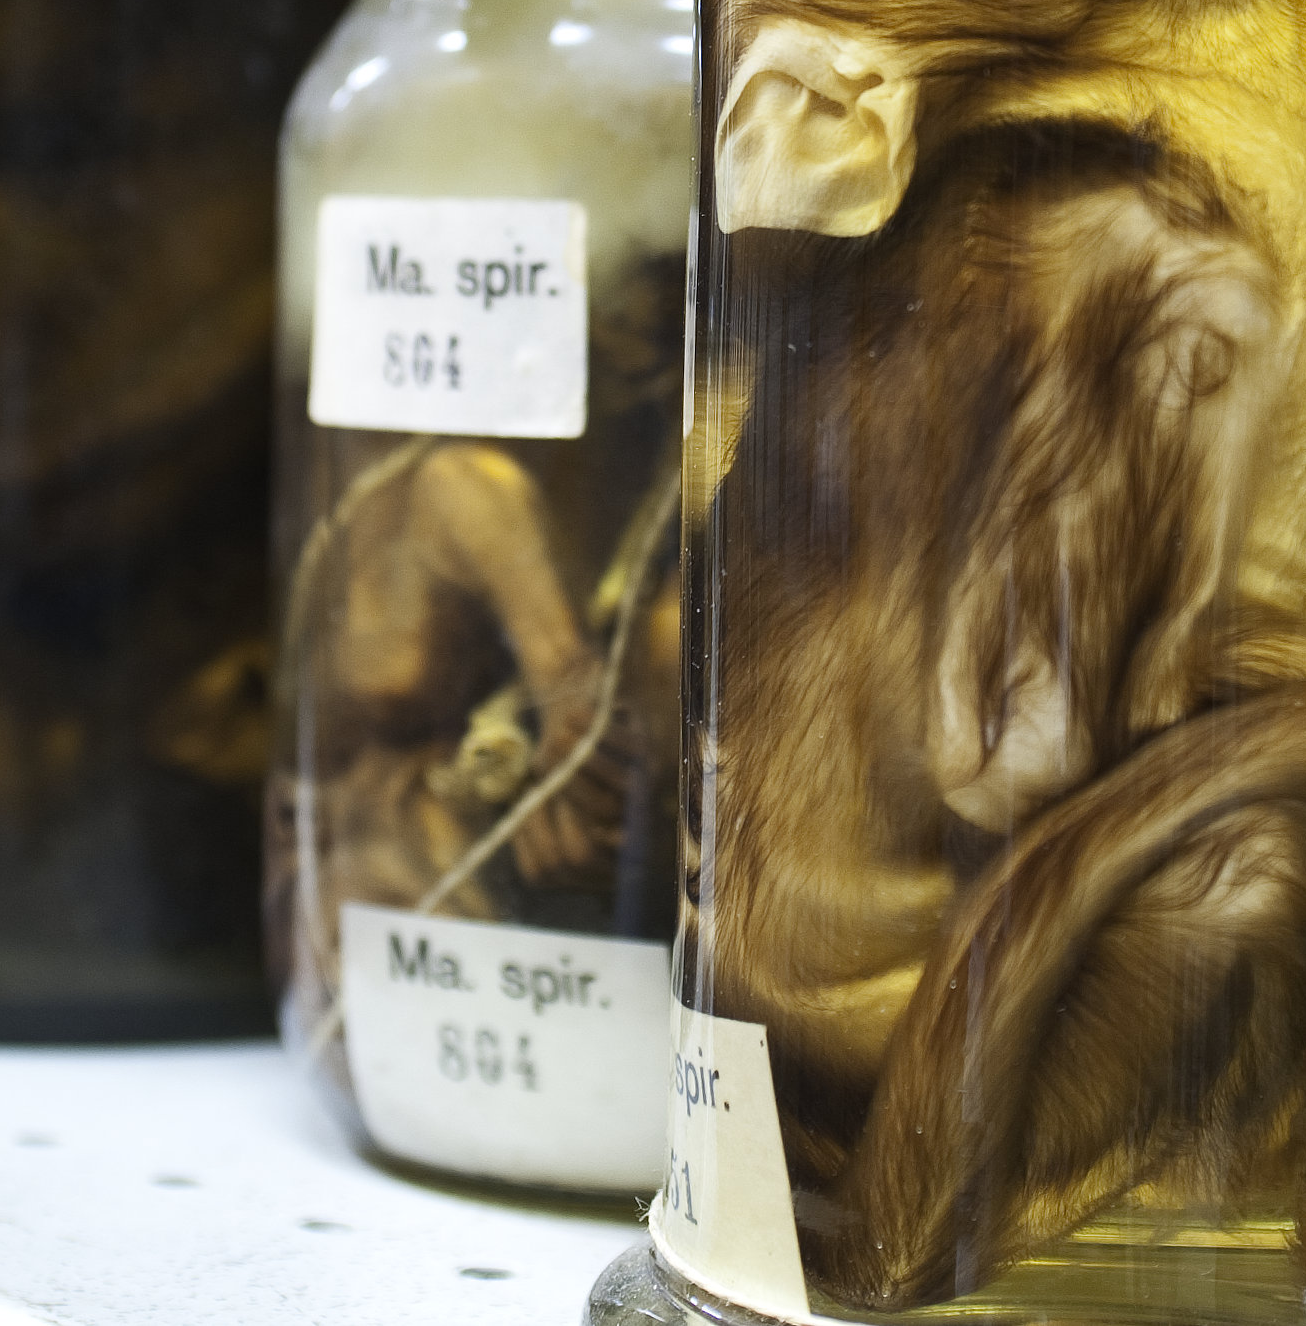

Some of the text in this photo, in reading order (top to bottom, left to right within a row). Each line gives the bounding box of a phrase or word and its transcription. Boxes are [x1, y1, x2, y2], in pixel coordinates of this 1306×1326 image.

[366, 241, 559, 311] Ma. spir.
[386, 931, 613, 1015] Ma. spir.
[674, 1045, 731, 1118] spir.
